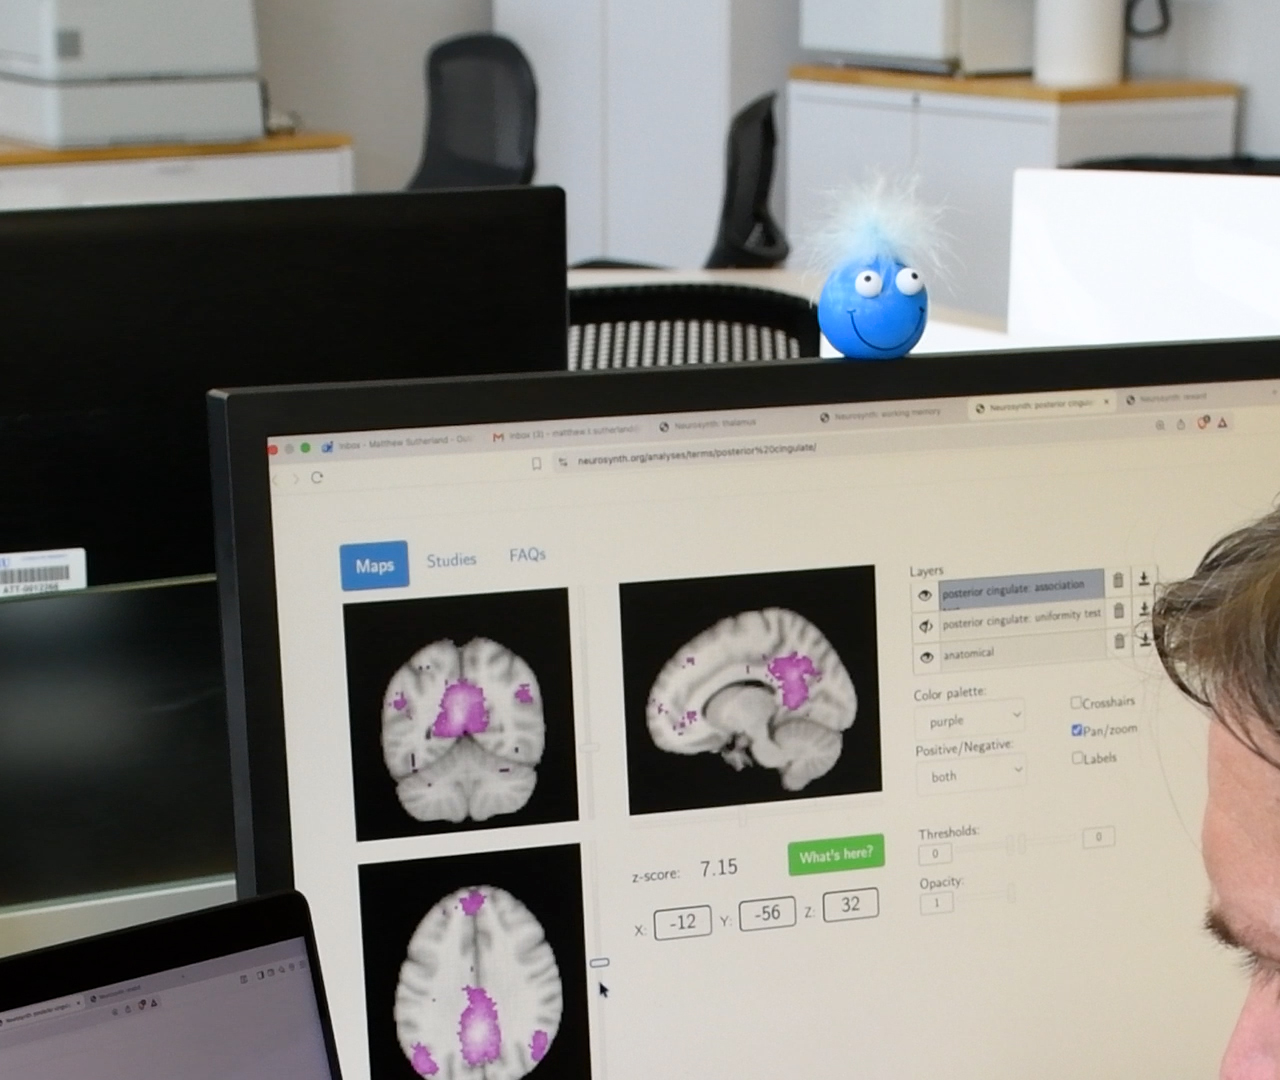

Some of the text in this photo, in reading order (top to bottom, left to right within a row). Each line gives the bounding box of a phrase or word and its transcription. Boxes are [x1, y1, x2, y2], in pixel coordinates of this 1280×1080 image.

[338, 441, 361, 450] Inbox
[370, 438, 403, 448] Matthew
[405, 435, 449, 446] Sutherland
[509, 430, 530, 440] Inbox
[578, 442, 817, 466] neurosynth.org/analyses/terms/posterior%20cingulate/
[355, 546, 546, 575] Maps Studies FAQs
[910, 564, 944, 579] Layers
[942, 578, 1085, 601] posterior cingulate: association
[943, 608, 1102, 632] posterior cingulate: uniformity test
[944, 647, 995, 661] anatomical
[914, 686, 987, 702] Color palette:
[1082, 695, 1136, 710] Crosshairs
[930, 714, 964, 731] purple
[1083, 723, 1138, 738] Pan/zoom
[915, 738, 1014, 758] Positive/Negative:
[1083, 751, 1118, 766] Labels
[931, 770, 957, 784] both
[918, 825, 980, 841] Thresholds:
[1095, 831, 1103, 842] 0
[799, 844, 874, 865] What's here?
[931, 848, 939, 859] 0
[632, 857, 738, 884] z-score: 7.15
[634, 895, 861, 937] X: -12 Y: -56 Z: 32
